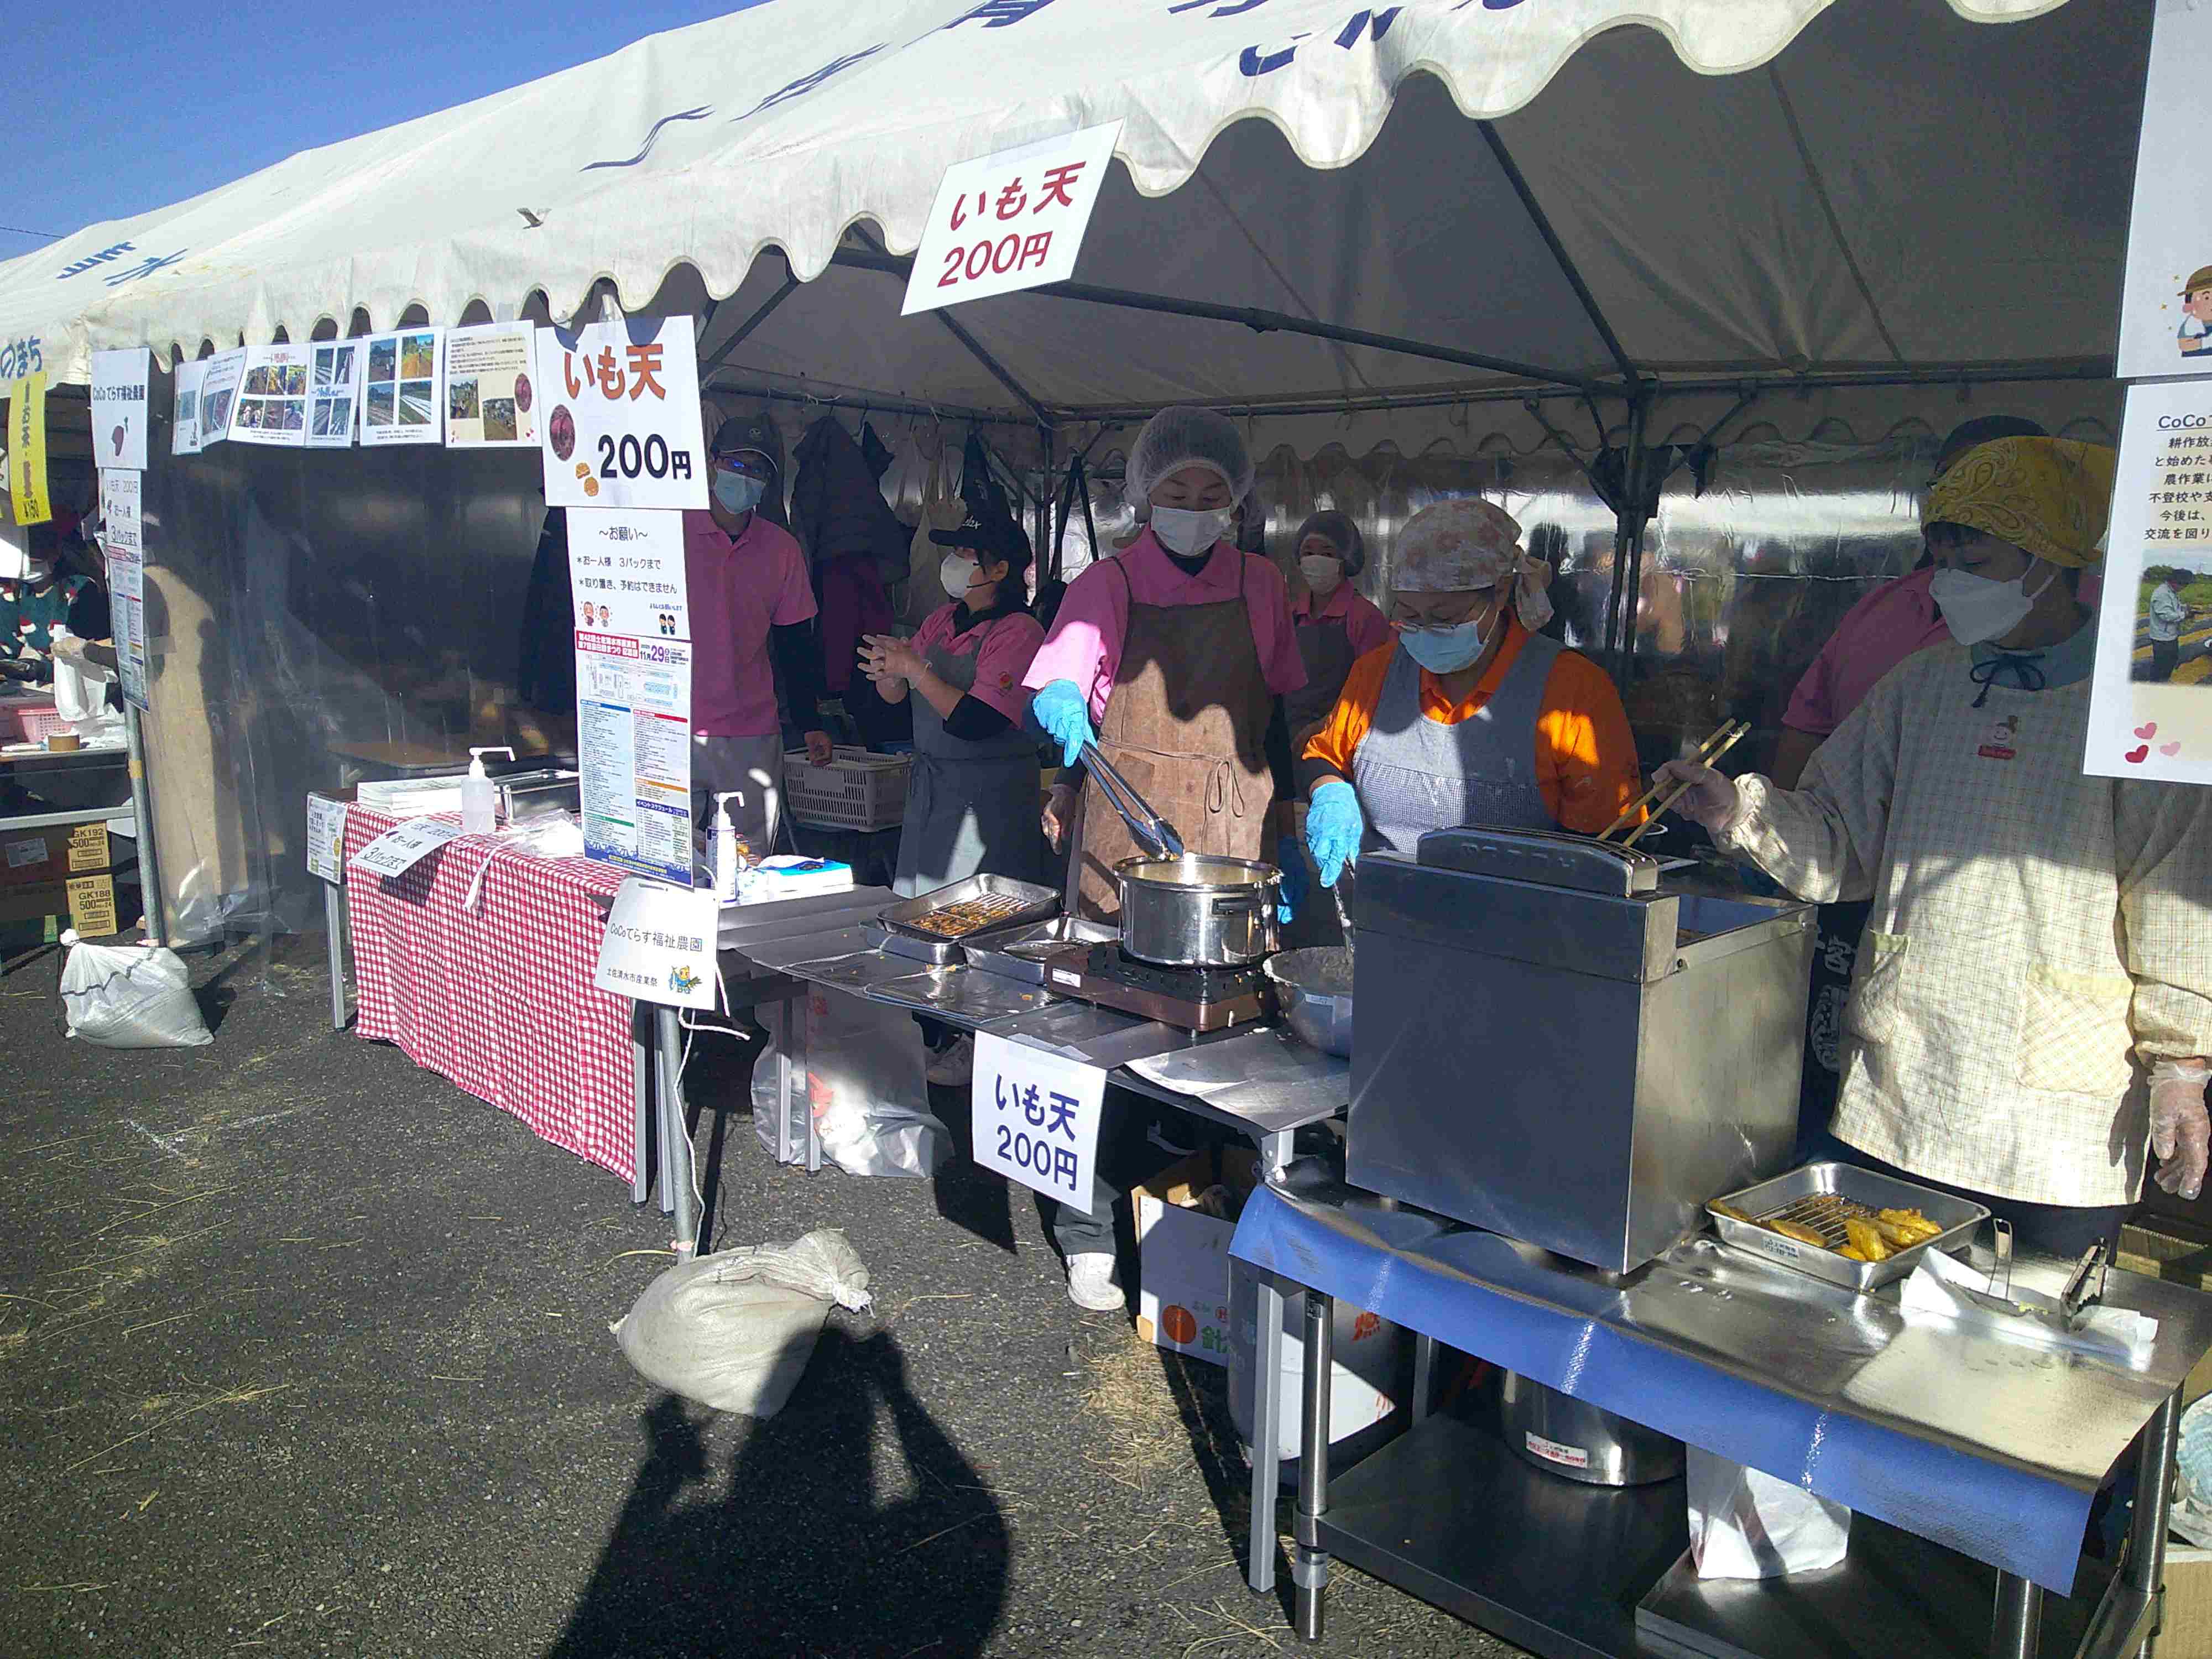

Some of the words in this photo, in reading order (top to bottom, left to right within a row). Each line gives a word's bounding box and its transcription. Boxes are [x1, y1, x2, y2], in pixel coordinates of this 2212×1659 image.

[950, 161, 1086, 231] いも天
[937, 230, 1053, 288] 200円
[564, 343, 666, 401] いも天
[2158, 414, 2212, 428] CoCo
[2168, 436, 2212, 448] 耕作放
[598, 434, 691, 480] 200円
[79, 890, 111, 900] GK188
[995, 1073, 1079, 1142] いも天
[997, 1124, 1078, 1192] 200円
